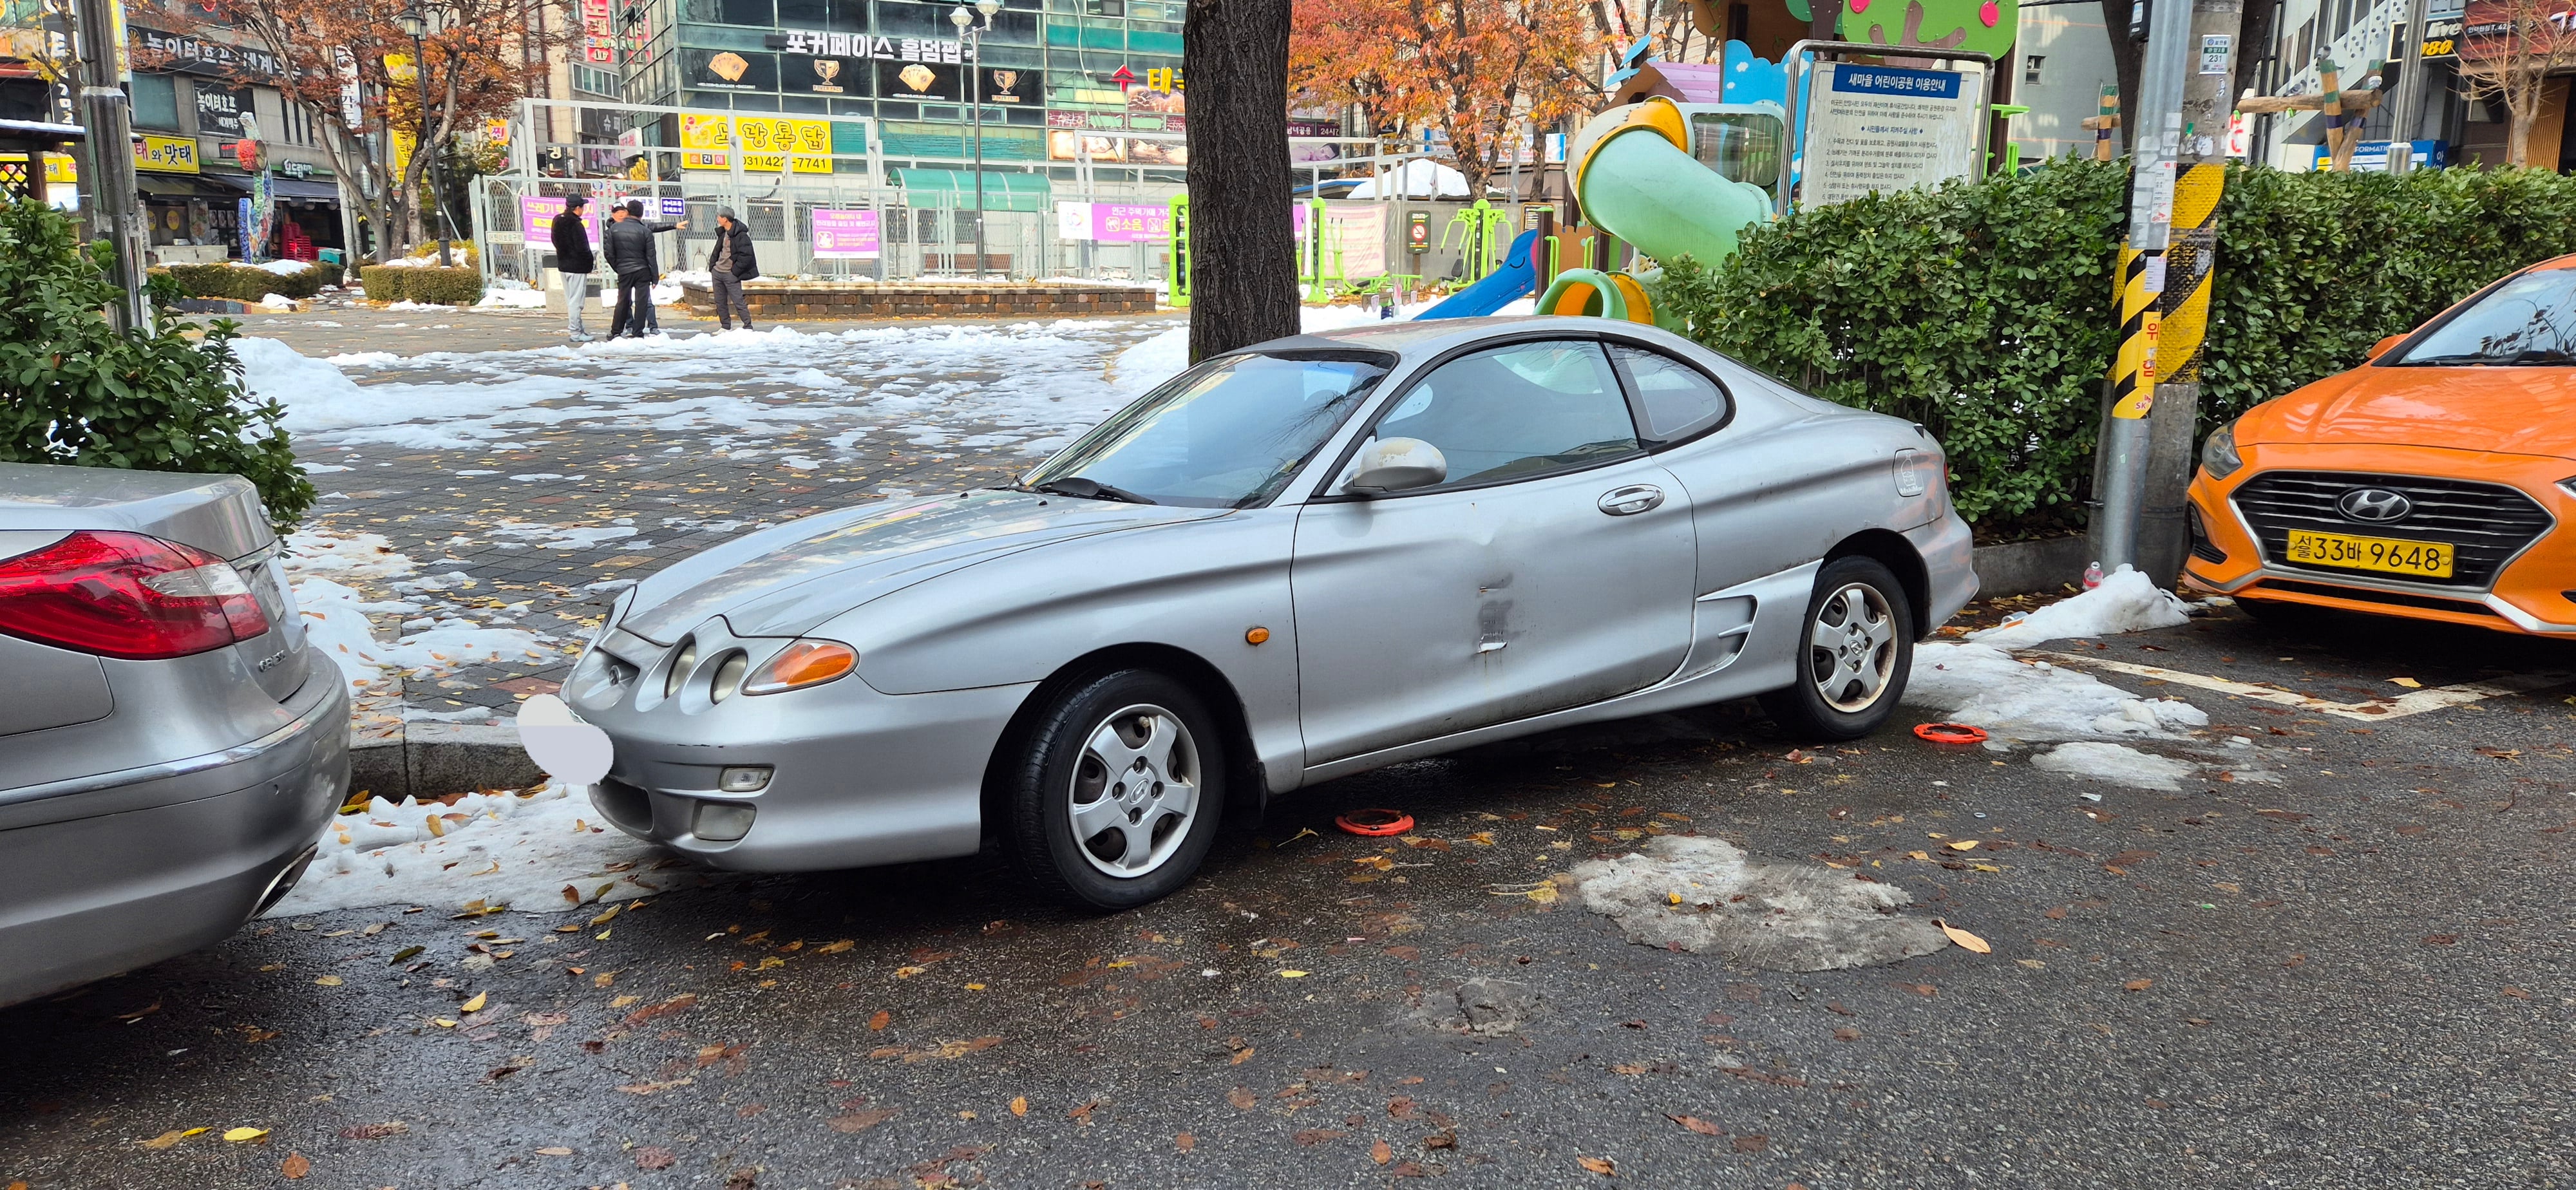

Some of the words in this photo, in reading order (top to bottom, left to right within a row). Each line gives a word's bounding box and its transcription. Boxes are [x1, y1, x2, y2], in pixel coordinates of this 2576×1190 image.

[786, 30, 895, 59] 포커페이스
[900, 39, 961, 63] 홀덤펍
[1848, 73, 1873, 87] 새마을
[1875, 75, 1913, 90] 어린이공원
[1915, 77, 1946, 92] 이용안내
[197, 91, 237, 113] 놀이터호프
[2297, 534, 2311, 558] 서울
[2313, 537, 2362, 563] 33바
[2370, 542, 2441, 571] 9648
